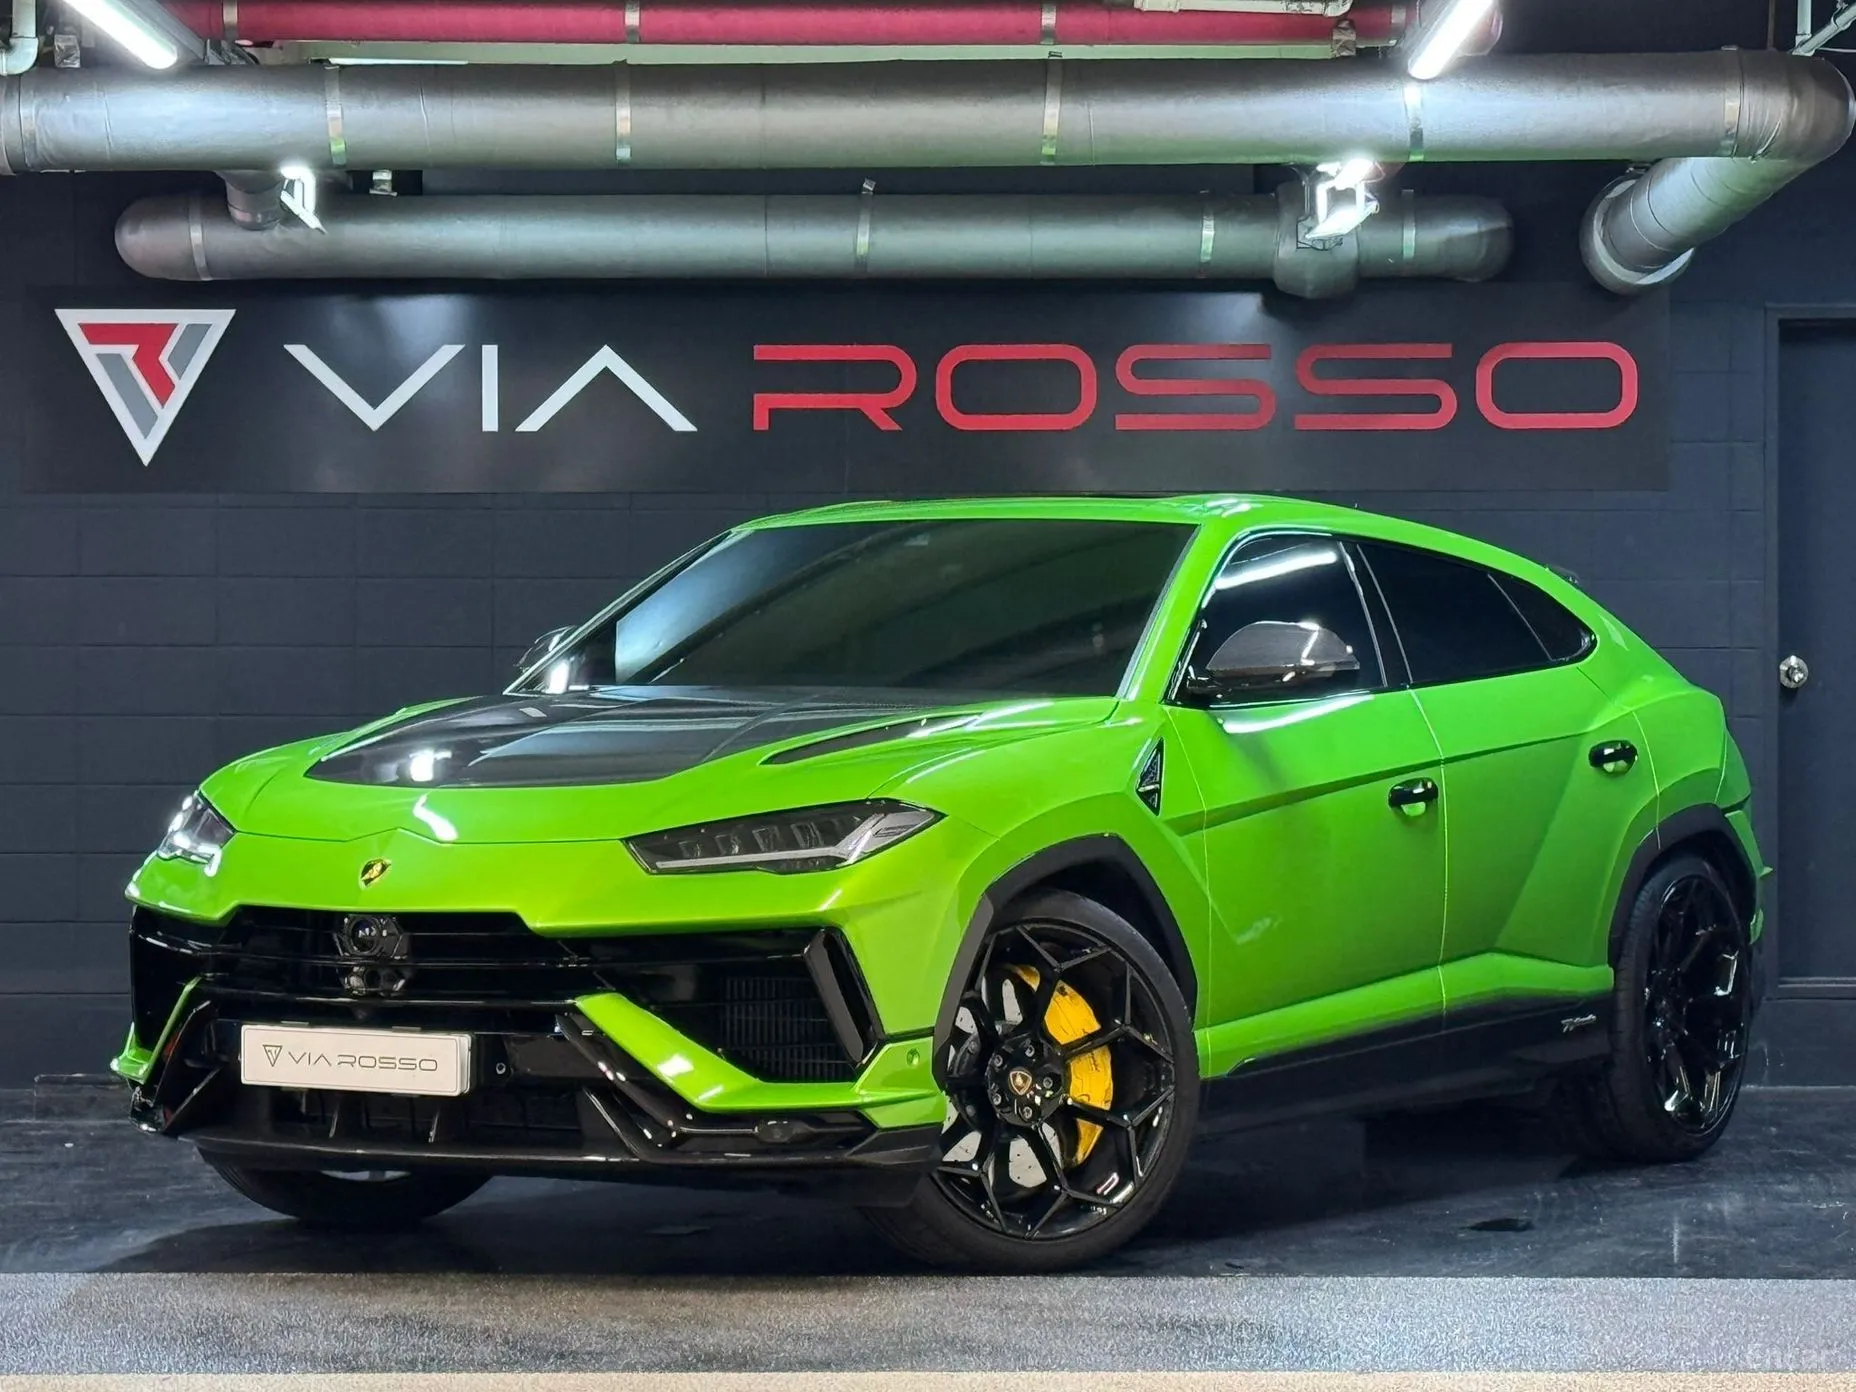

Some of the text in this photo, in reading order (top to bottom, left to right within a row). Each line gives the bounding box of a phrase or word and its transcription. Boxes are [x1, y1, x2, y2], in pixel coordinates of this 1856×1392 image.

[284, 341, 1639, 432] VIA ROSSO
[287, 1051, 438, 1072] VIA ROSSO
